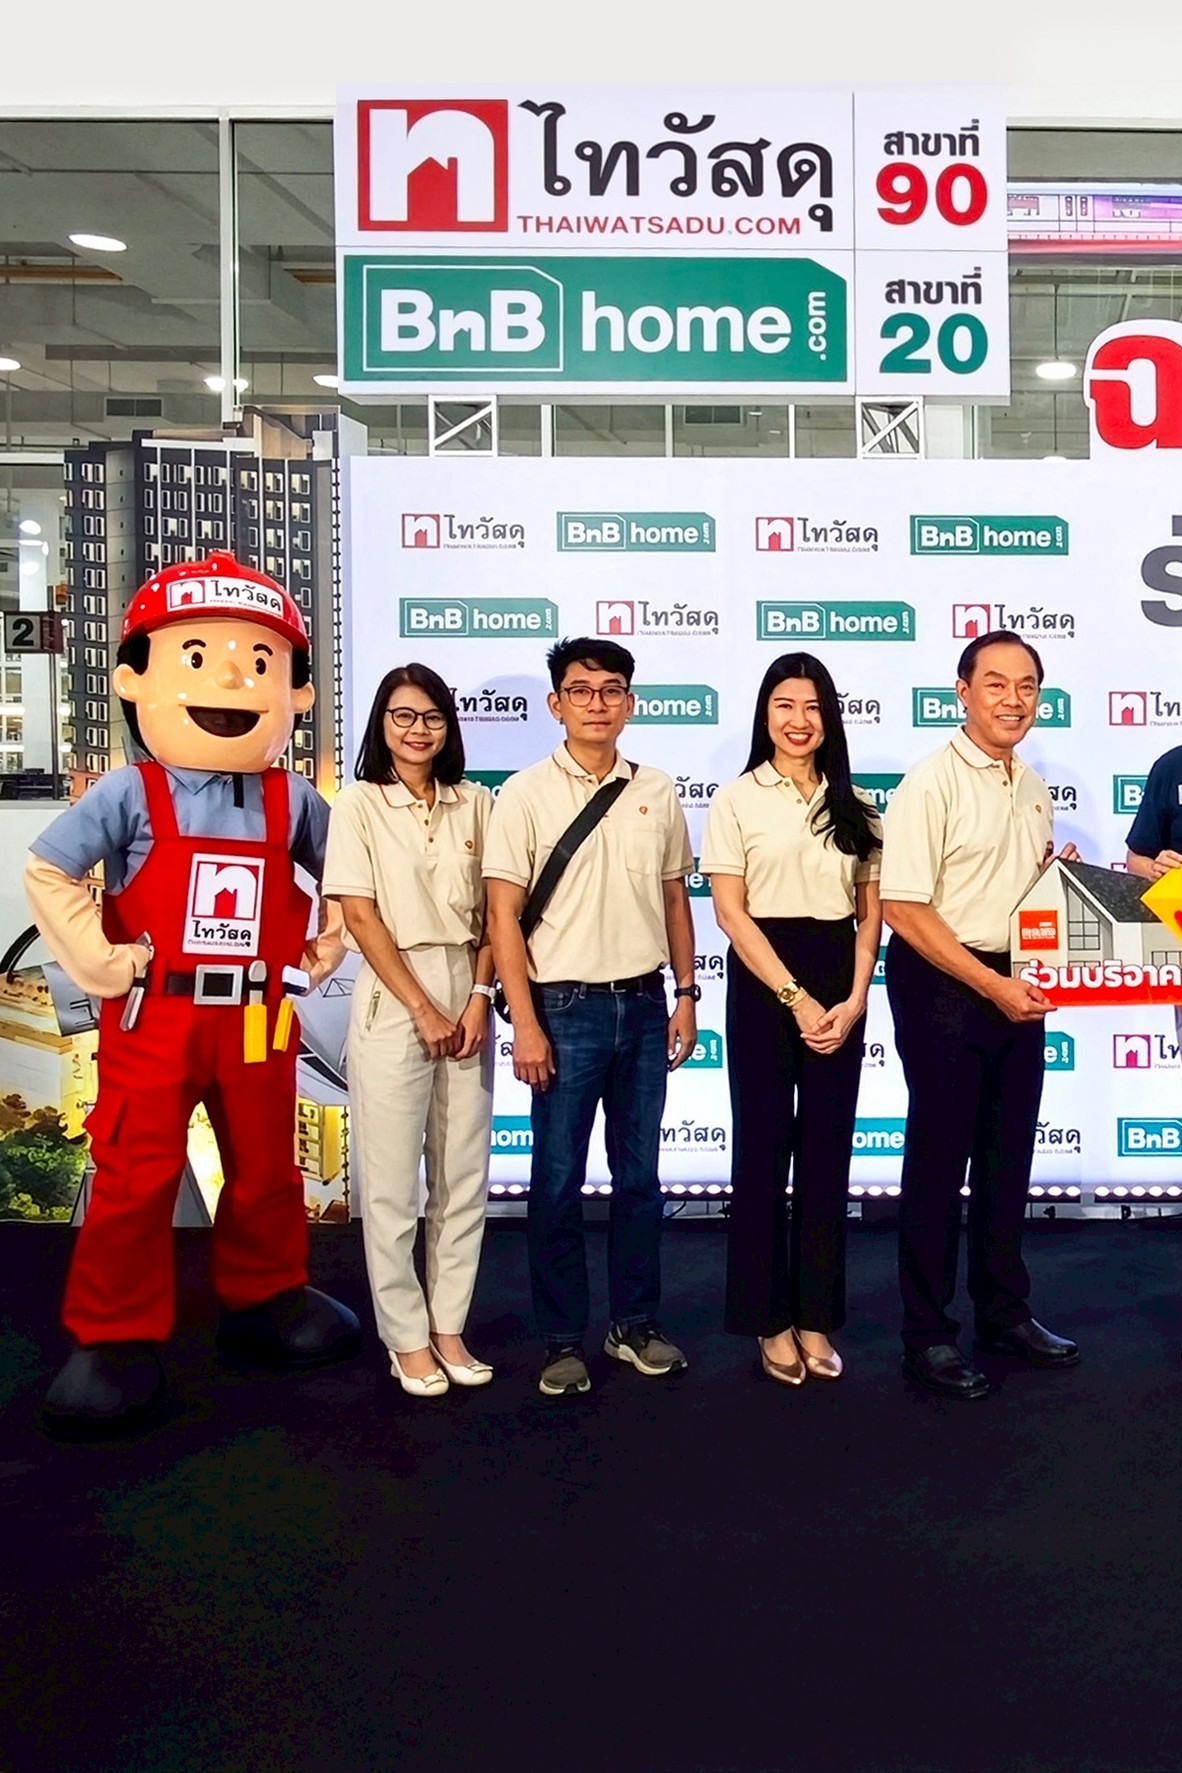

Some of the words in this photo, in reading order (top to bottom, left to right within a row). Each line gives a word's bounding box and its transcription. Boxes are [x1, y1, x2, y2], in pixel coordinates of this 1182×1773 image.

[883, 119, 980, 157] สาขาที่
[518, 100, 833, 232] ไทวัสดุ
[876, 163, 988, 226] 90
[885, 266, 983, 305] สาขาที่
[380, 289, 546, 352] BnB
[582, 290, 791, 353] home
[879, 312, 988, 374] 20
[567, 522, 621, 543] BnB
[630, 522, 699, 544] home
[921, 525, 974, 547] BnB
[983, 525, 1051, 548] home
[409, 608, 463, 629] BnB
[473, 608, 541, 630] home
[767, 611, 821, 633] BnB
[830, 611, 898, 634] home
[12, 618, 34, 646] 2
[633, 694, 701, 717] home
[852, 1131, 905, 1149] ome
[1128, 1127, 1181, 1149] BnB
